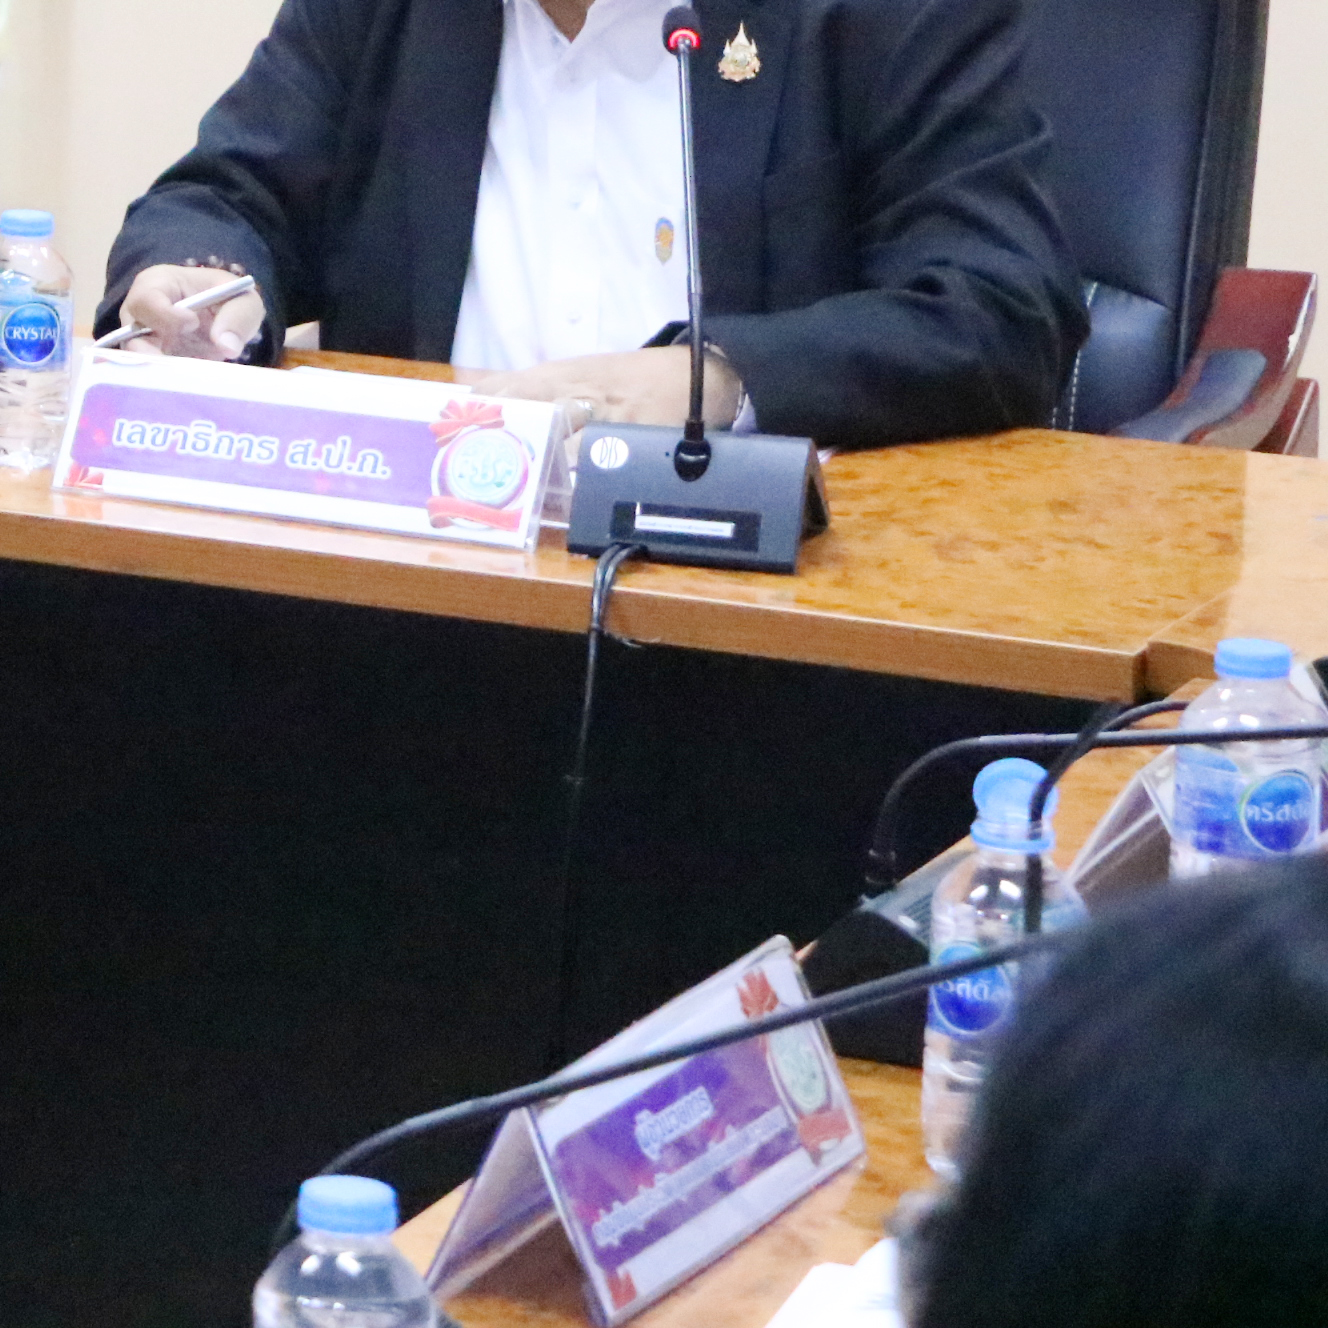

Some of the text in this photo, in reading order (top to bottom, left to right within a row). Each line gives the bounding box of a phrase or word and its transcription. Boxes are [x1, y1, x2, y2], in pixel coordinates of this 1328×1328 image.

[113, 419, 391, 477] เลขาธิการ ส.ป.ก.
